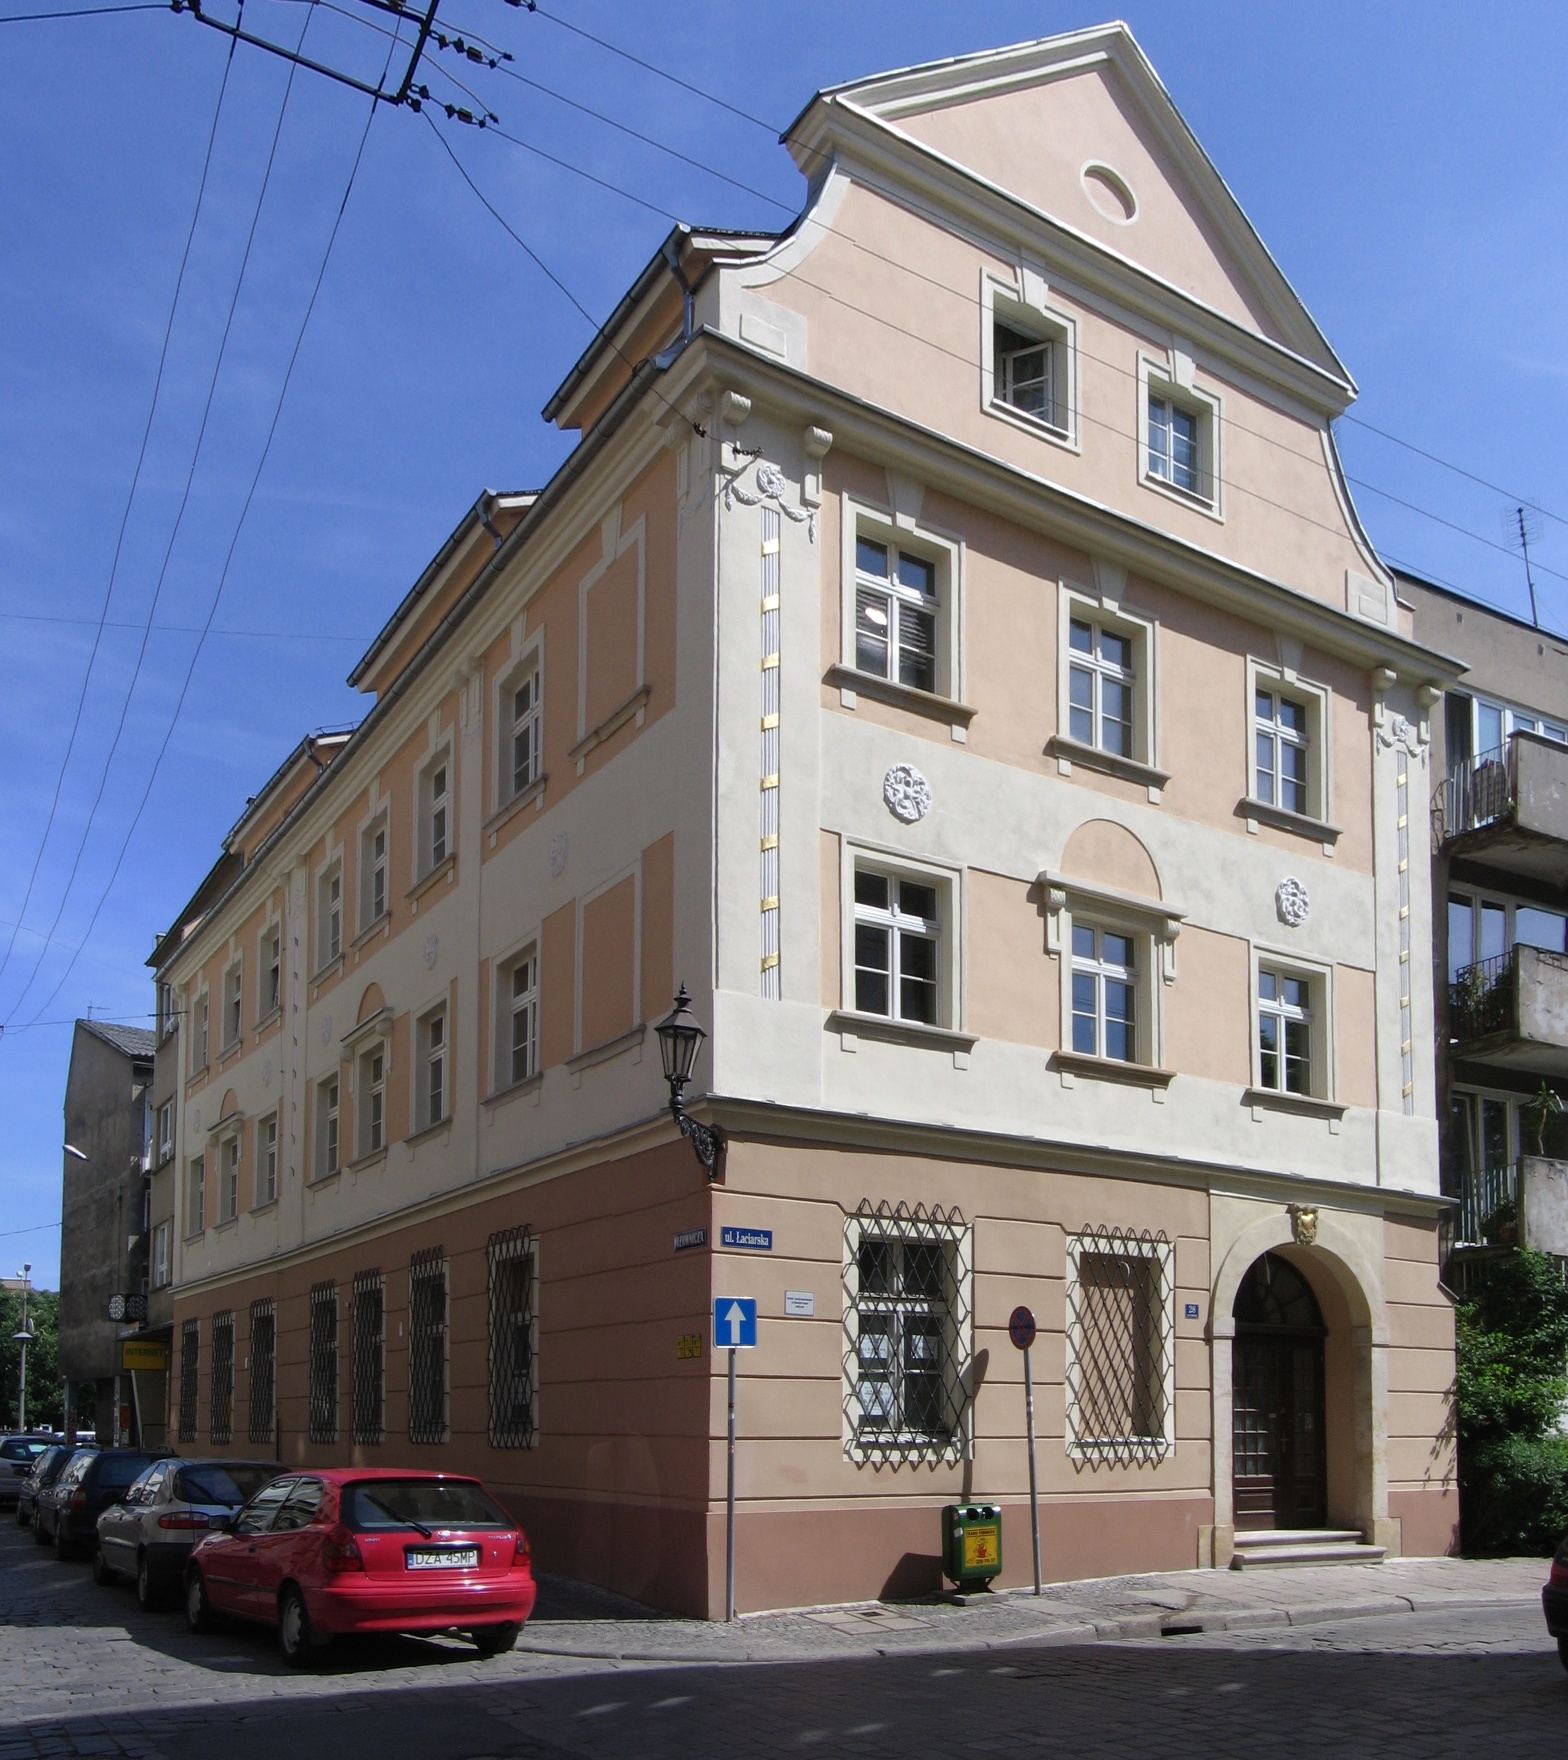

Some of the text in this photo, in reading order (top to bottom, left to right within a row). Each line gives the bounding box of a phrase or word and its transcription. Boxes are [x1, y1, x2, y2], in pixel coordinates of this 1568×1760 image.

[724, 1231, 769, 1246] ul. Łaciarska
[125, 1347, 163, 1356] INTERNET
[415, 1550, 475, 1565] DZA 45MP
